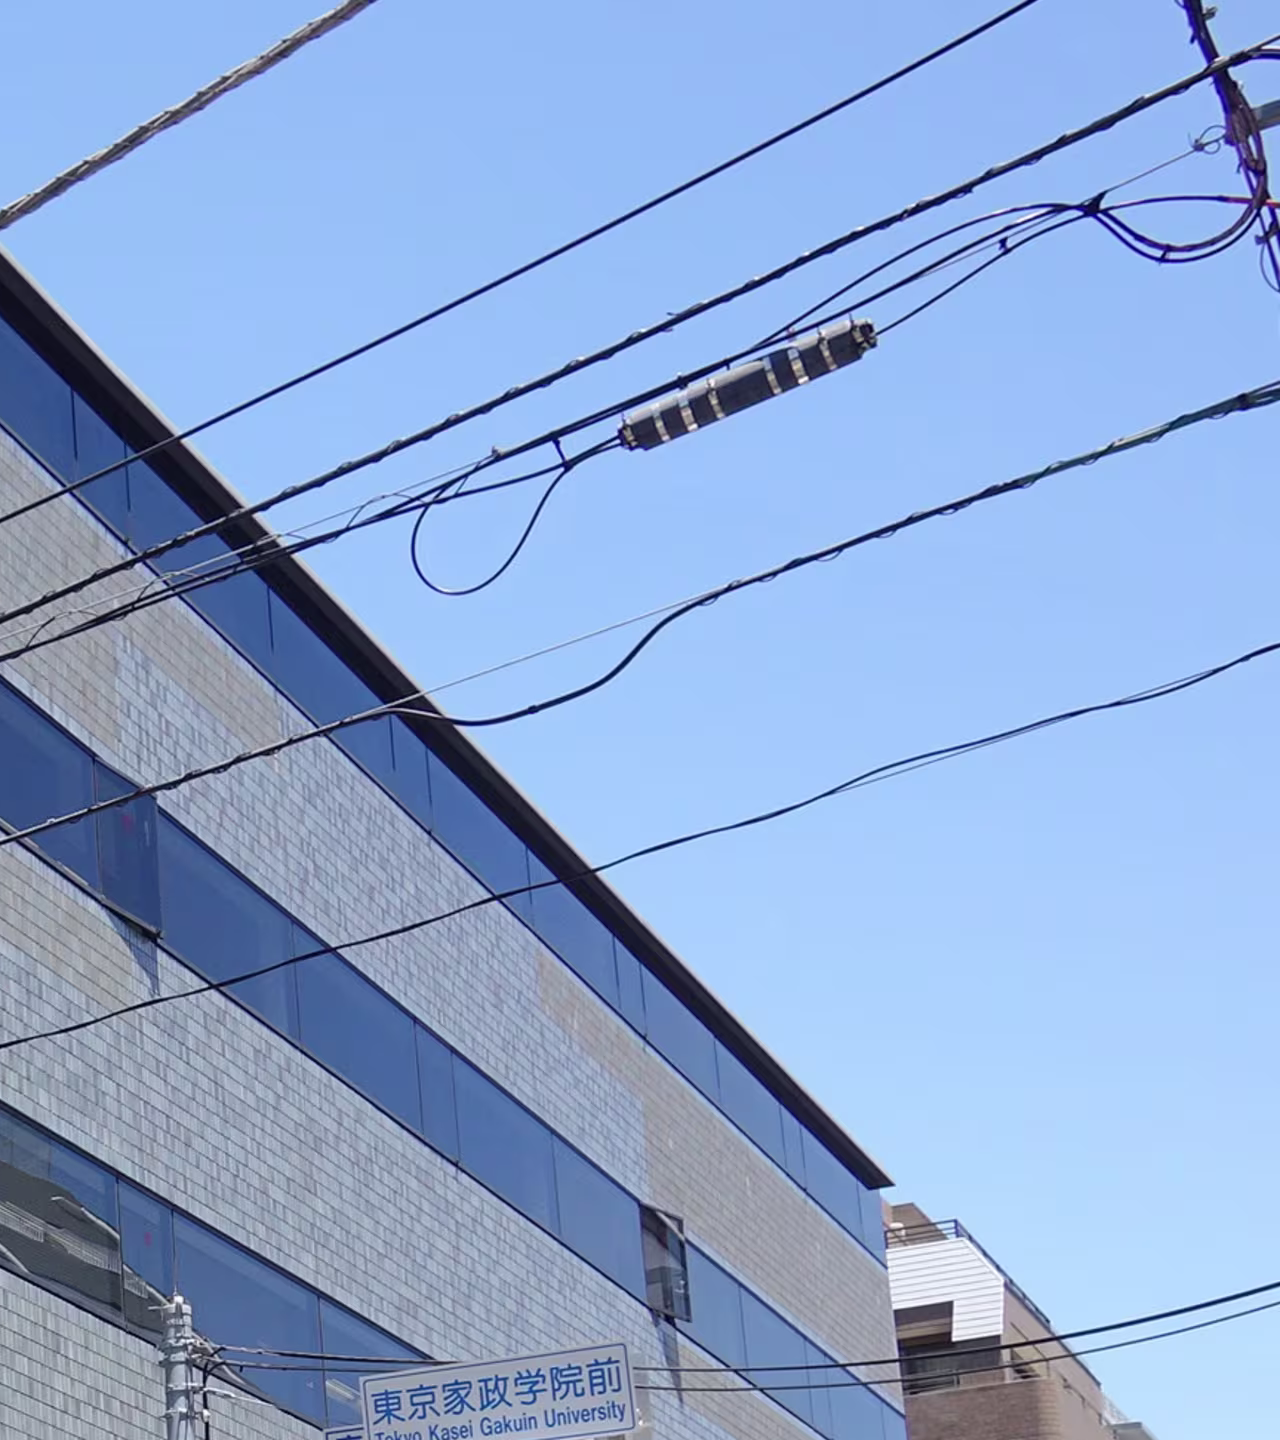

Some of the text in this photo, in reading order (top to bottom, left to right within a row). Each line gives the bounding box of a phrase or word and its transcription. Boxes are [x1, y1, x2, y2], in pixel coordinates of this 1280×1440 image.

[370, 1356, 622, 1428] 東京家政学院前
[428, 1420, 473, 1440] Kasei
[479, 1412, 538, 1436] Gakuin
[545, 1400, 626, 1428] University
